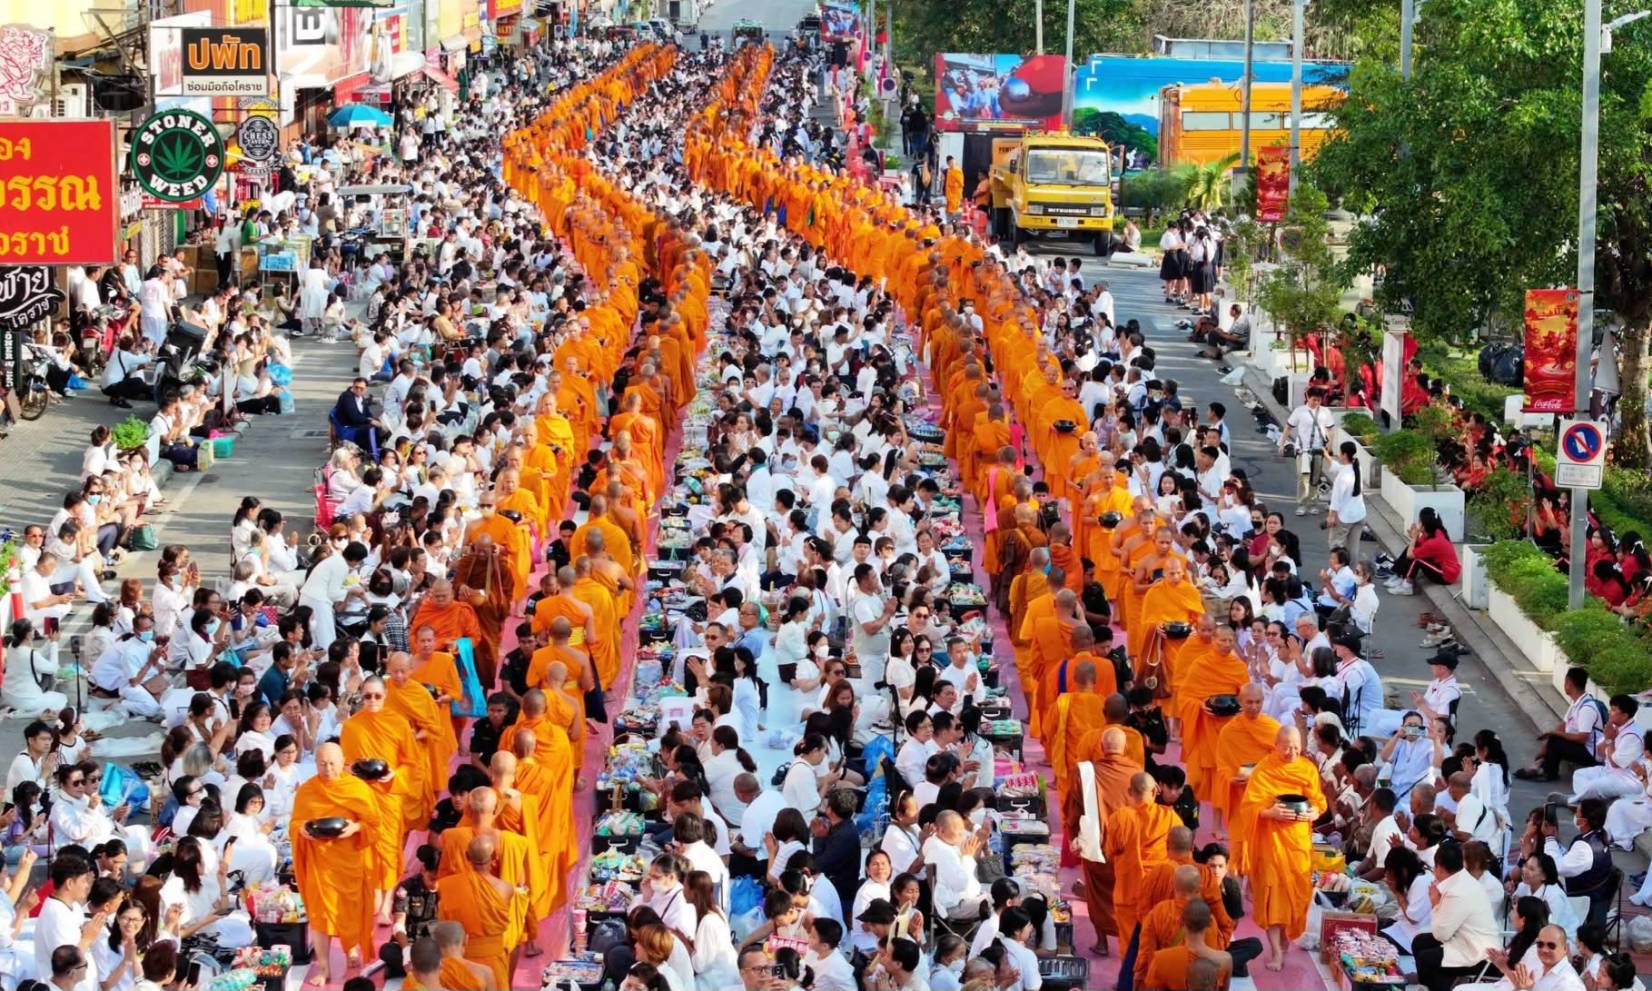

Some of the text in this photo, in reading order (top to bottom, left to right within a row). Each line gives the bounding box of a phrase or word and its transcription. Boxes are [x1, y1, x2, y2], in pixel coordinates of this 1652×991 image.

[188, 35, 261, 70] ปพัท
[141, 115, 215, 147] STONER
[150, 174, 208, 196] WEED
[1534, 399, 1562, 408] Coca-Cola
